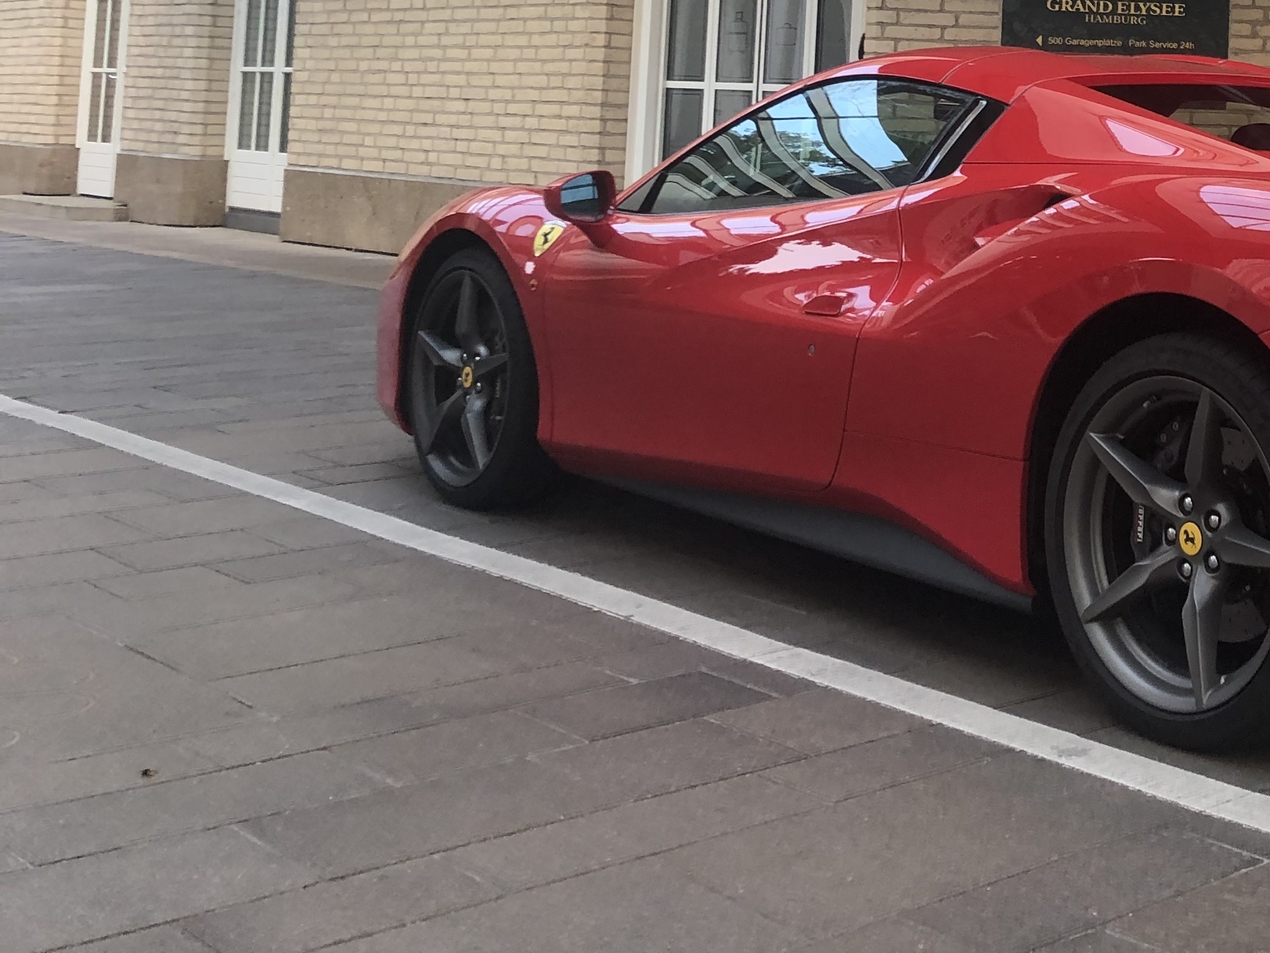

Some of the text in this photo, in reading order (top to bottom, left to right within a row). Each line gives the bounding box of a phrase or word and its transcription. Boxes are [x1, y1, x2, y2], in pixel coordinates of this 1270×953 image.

[1117, 1, 1186, 16] ELYSEE
[1085, 14, 1147, 25] HAMBURG
[1048, 37, 1063, 45] 500
[1129, 39, 1147, 47] Park
[1150, 40, 1178, 49] Service
[1180, 41, 1195, 49] 24h
